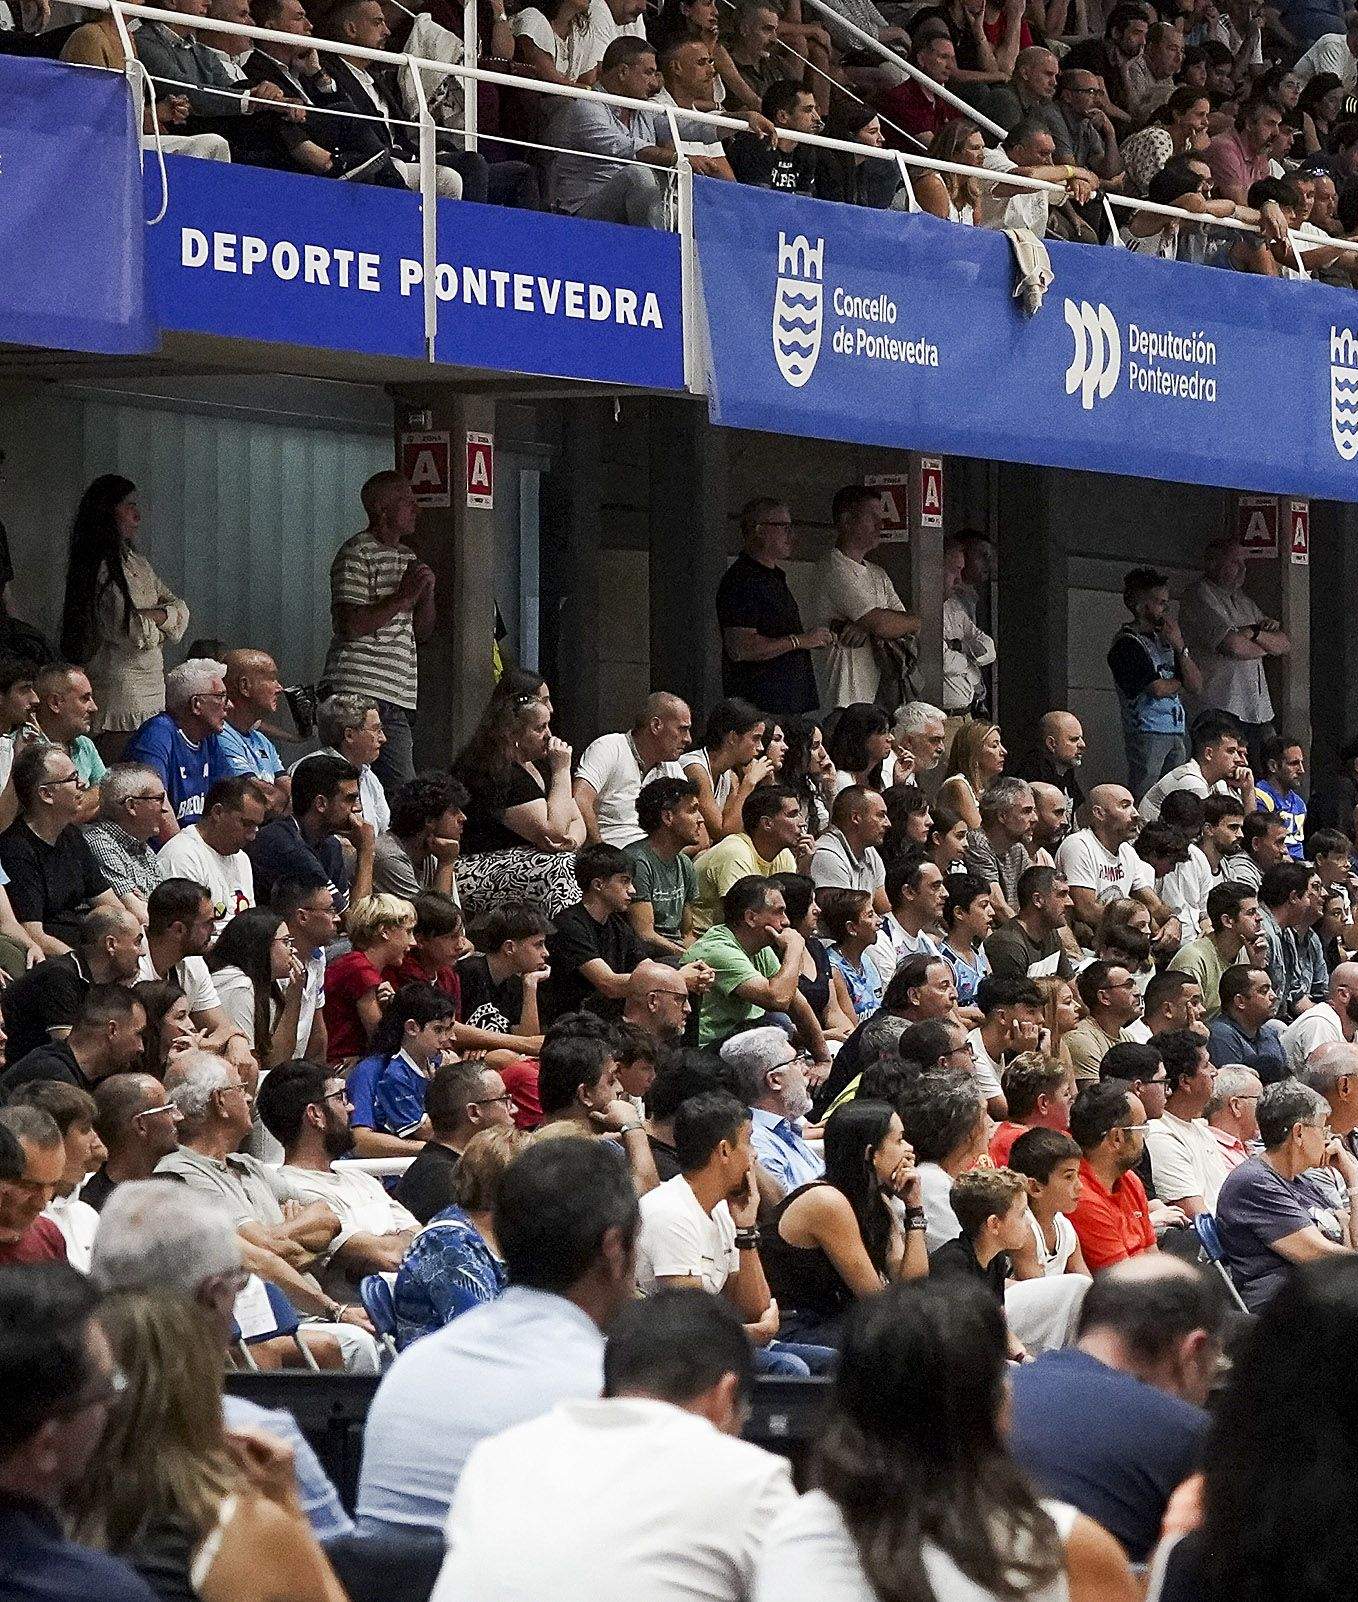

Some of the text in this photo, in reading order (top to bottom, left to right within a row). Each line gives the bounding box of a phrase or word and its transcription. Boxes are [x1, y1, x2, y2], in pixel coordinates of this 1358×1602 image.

[181, 227, 664, 330] DEPORTE PONTEVEDRA
[833, 286, 897, 326] Concello
[833, 323, 940, 367] de Pontevedra
[1128, 323, 1217, 366] Deputación
[1128, 360, 1217, 403] Pontevedra
[408, 449, 442, 487] A
[471, 450, 489, 487] A
[925, 475, 940, 508] A
[1244, 511, 1272, 540] A
[1293, 516, 1306, 547] A
